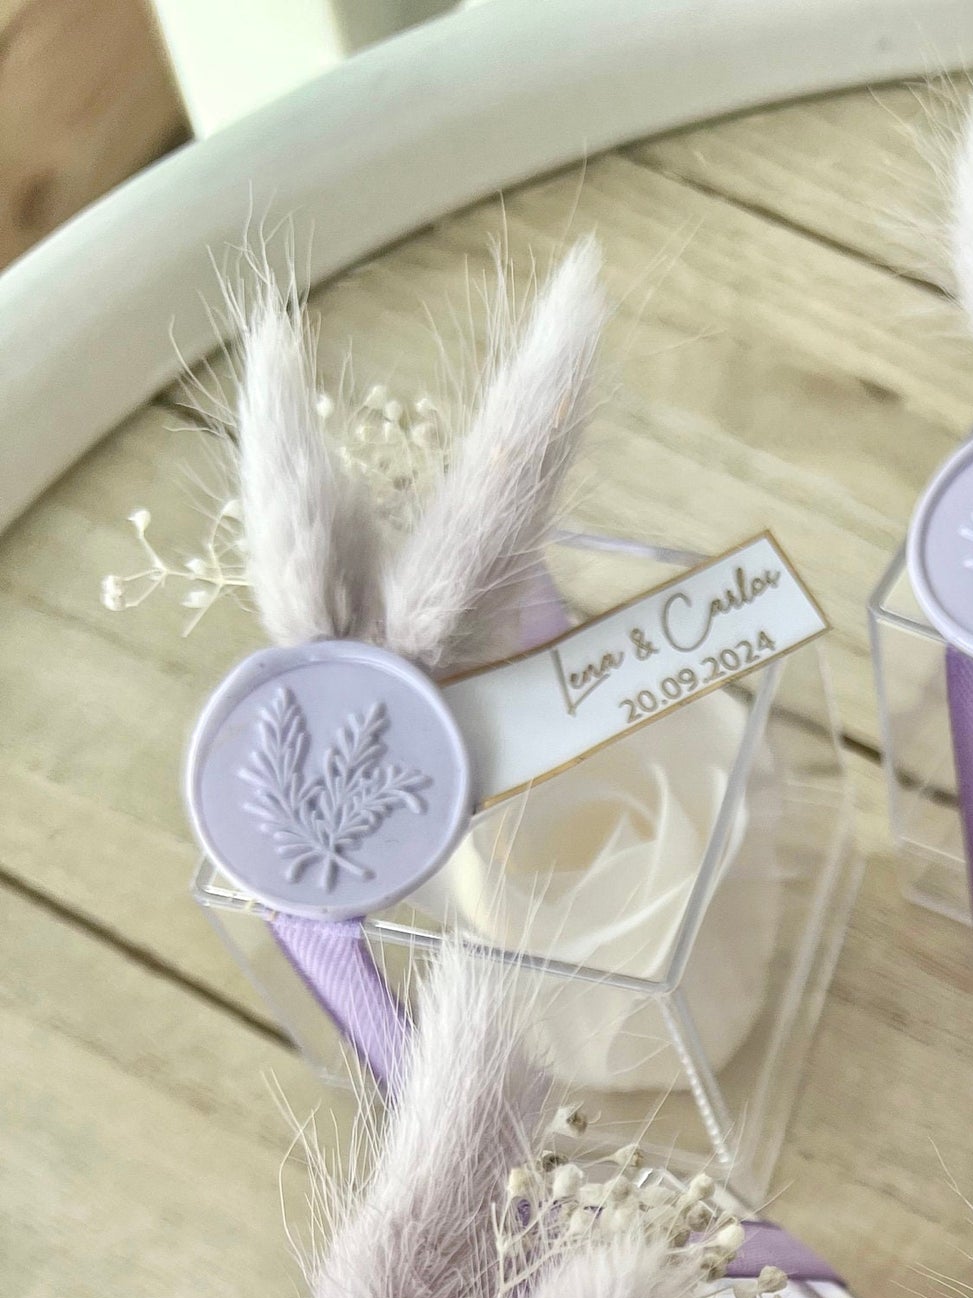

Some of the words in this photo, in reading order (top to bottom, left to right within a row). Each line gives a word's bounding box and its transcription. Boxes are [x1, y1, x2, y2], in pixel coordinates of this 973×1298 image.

[553, 648, 624, 717] Lena
[629, 627, 660, 661] &
[662, 567, 781, 653] Carlos
[618, 630, 777, 724] 20.09.2024
